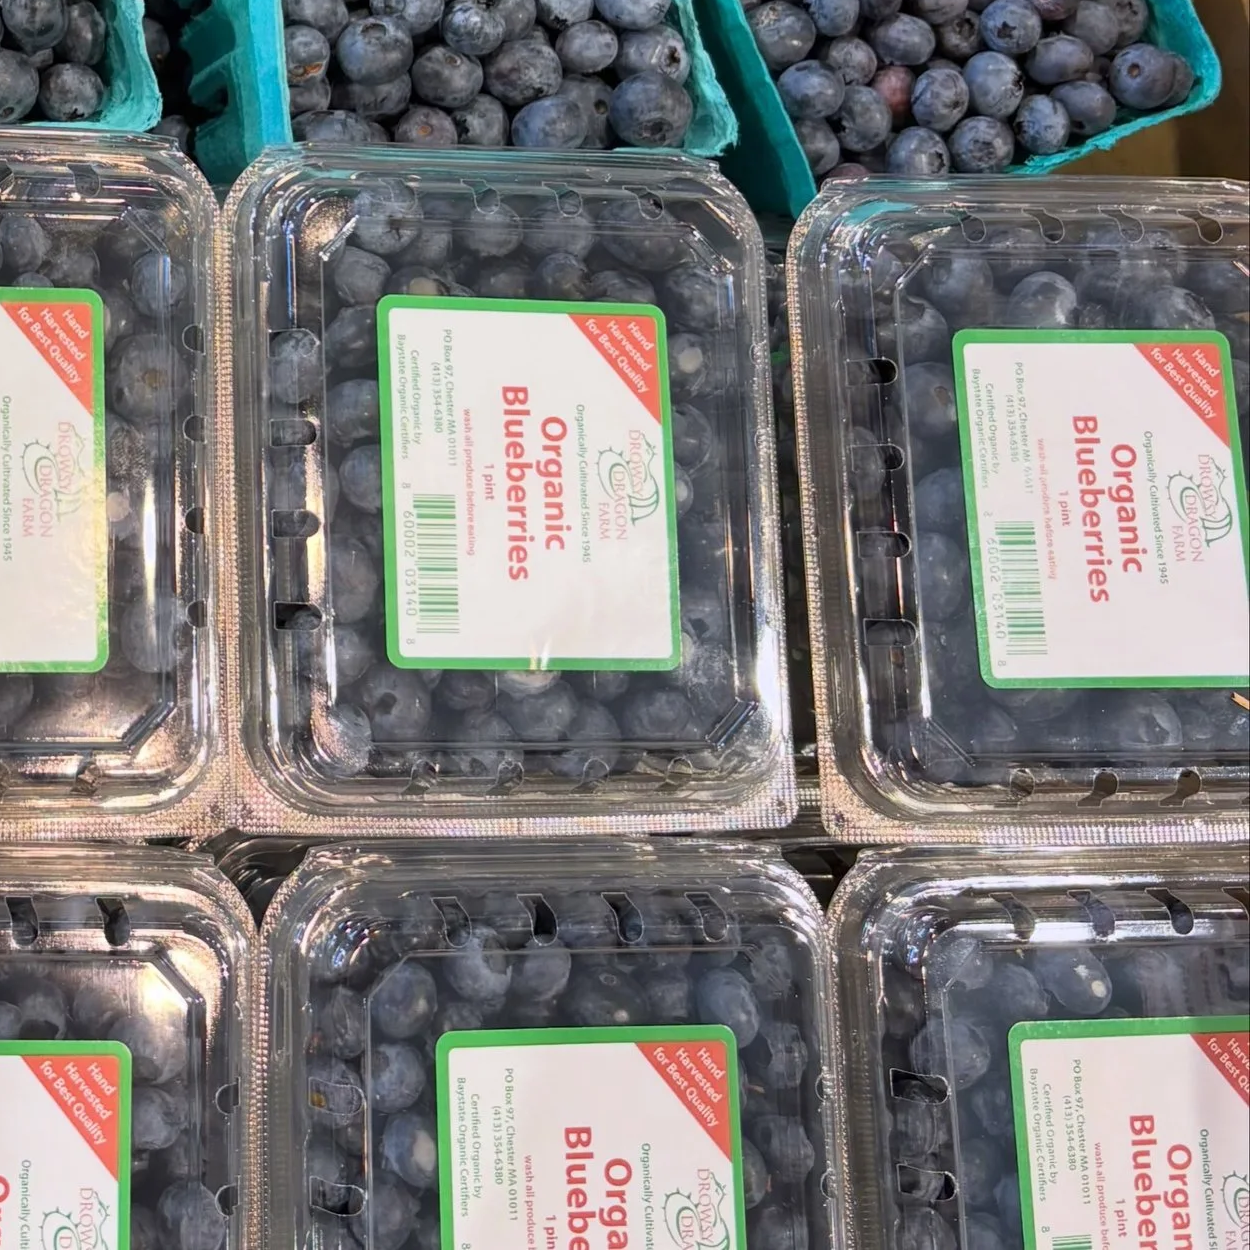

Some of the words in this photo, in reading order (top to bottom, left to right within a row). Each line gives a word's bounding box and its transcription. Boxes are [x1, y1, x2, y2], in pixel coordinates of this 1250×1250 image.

[16, 306, 32, 324] for
[29, 322, 52, 348] Best
[48, 345, 81, 384] Quality
[39, 308, 87, 362] Harvested
[61, 309, 90, 340] Hand
[442, 328, 453, 344] PO
[626, 321, 655, 351] Hand
[395, 333, 406, 375] Baystate
[442, 344, 453, 363] Box
[584, 318, 600, 335] for
[597, 333, 619, 358] Best
[616, 356, 649, 393] Quality
[606, 320, 653, 372] Harvested
[1189, 347, 1218, 376] Hand
[409, 349, 421, 391] Certified
[429, 361, 442, 386] (413)
[441, 364, 453, 379] 97,
[1147, 346, 1164, 363] for
[1161, 361, 1183, 385] Best
[1180, 382, 1215, 418] Quality
[1168, 347, 1217, 397] Harvested
[396, 375, 408, 414] Organic
[409, 391, 422, 430] Organic
[430, 387, 444, 433] 354-6380
[444, 380, 454, 418] Chester
[0, 395, 14, 453] Organically
[399, 415, 411, 460] Certifiers
[410, 432, 423, 445] by
[446, 418, 457, 435] MA
[462, 408, 473, 434] wash
[463, 434, 474, 447] all
[573, 403, 588, 459] Organically
[57, 422, 72, 492] DROWSY
[446, 437, 457, 466] 01011
[462, 448, 475, 490] produce
[627, 429, 645, 497] DROWSY
[1142, 430, 1159, 484] Organically
[2, 454, 13, 506] Cultivated
[400, 481, 411, 489] 8
[481, 473, 496, 500] pint
[501, 385, 535, 581] Blueberries
[534, 416, 572, 550] Organic
[577, 459, 590, 510] Cultivated
[1196, 454, 1217, 520] DROWSY
[2, 508, 13, 536] Since
[20, 498, 33, 538] FARM
[38, 465, 52, 538] DRAGON
[465, 490, 476, 523] before
[597, 502, 610, 540] FARM
[611, 471, 628, 540] DRAGON
[1057, 501, 1072, 527] pint
[1070, 415, 1113, 604] Blueberries
[1107, 443, 1148, 574] Organic
[1149, 485, 1164, 534] Cultivated
[402, 510, 416, 558] 60002
[465, 523, 476, 556] eating
[580, 511, 591, 538] Since
[1170, 526, 1186, 563] FARM
[1183, 495, 1203, 563] DRAGON
[1, 537, 12, 562] 1945
[581, 539, 591, 563] 1945
[1154, 535, 1165, 561] Since
[403, 568, 418, 616] 03140
[1157, 563, 1168, 586] 1945
[405, 637, 416, 645] 8
[503, 1068, 514, 1085] PO
[674, 1047, 723, 1103] Harvested
[696, 1047, 726, 1080] Hand
[1205, 1037, 1221, 1054] for
[1218, 1052, 1240, 1078] Best
[63, 1061, 113, 1120] Harvested
[86, 1062, 117, 1096] Hand
[503, 1086, 514, 1107] Box
[651, 1047, 668, 1065] for
[665, 1063, 688, 1090] Best
[685, 1087, 719, 1127] Quality
[39, 1060, 56, 1080] for
[52, 1078, 76, 1106] Best
[72, 1103, 106, 1145] Quality
[502, 1107, 514, 1125] 97,
[505, 1126, 515, 1167] Chester
[1093, 1142, 1104, 1169] wash
[1198, 1128, 1213, 1187] Organically
[506, 1168, 517, 1187] MA
[523, 1155, 534, 1184] wash
[563, 1127, 597, 1250] Bluebe
[639, 1143, 654, 1204] Organically
[1095, 1169, 1106, 1183] all
[1128, 1114, 1162, 1250] Blueber
[18, 1160, 33, 1223] Organically
[507, 1188, 518, 1221] 01011
[524, 1184, 535, 1198] all
[598, 1158, 633, 1250] Orga
[696, 1169, 714, 1244] DROWSY
[1094, 1184, 1107, 1228] produce
[1162, 1143, 1193, 1250] Organ
[77, 1188, 94, 1250] DROW
[523, 1199, 536, 1245] produce
[1113, 1209, 1127, 1238] pint
[1203, 1187, 1217, 1240] Cultivated
[542, 1226, 558, 1250] pin
